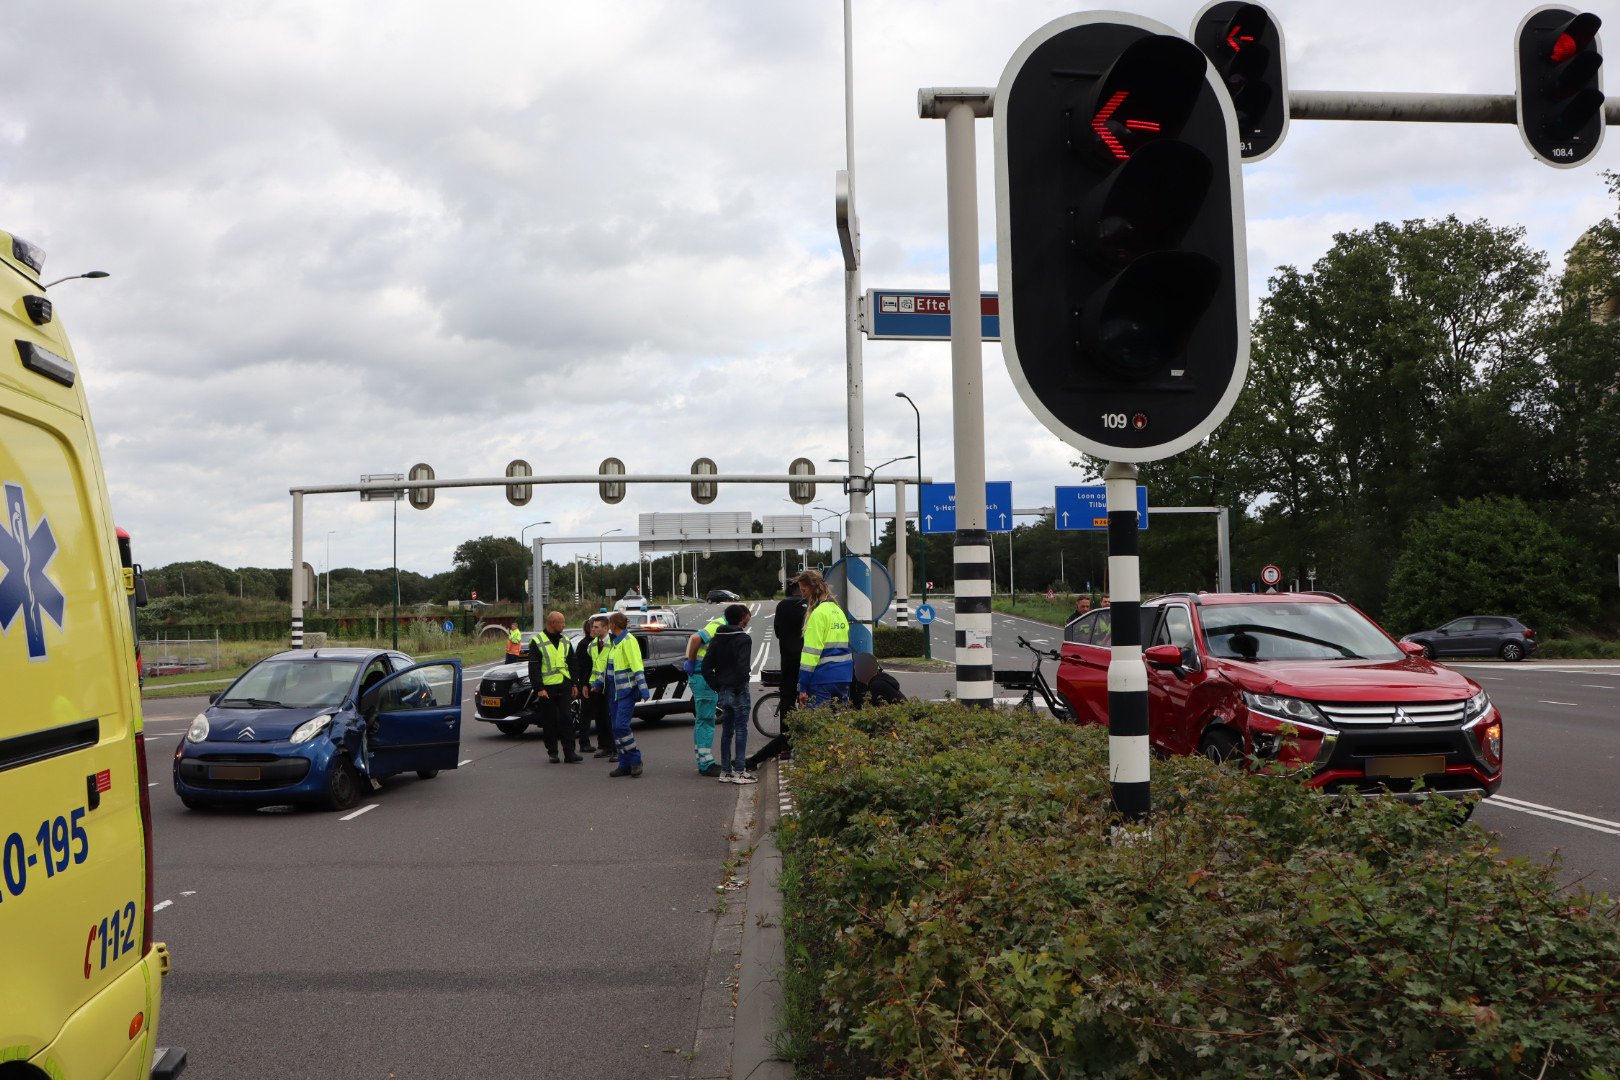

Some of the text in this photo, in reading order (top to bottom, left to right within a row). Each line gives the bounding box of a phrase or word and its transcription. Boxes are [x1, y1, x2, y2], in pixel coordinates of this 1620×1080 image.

[1240, 141, 1252, 151] 9.1
[1552, 148, 1574, 157] 108.4
[917, 298, 950, 311] Eftel
[1101, 413, 1127, 429] 109
[1077, 492, 1095, 500] Loon
[0, 806, 89, 904] 0-195
